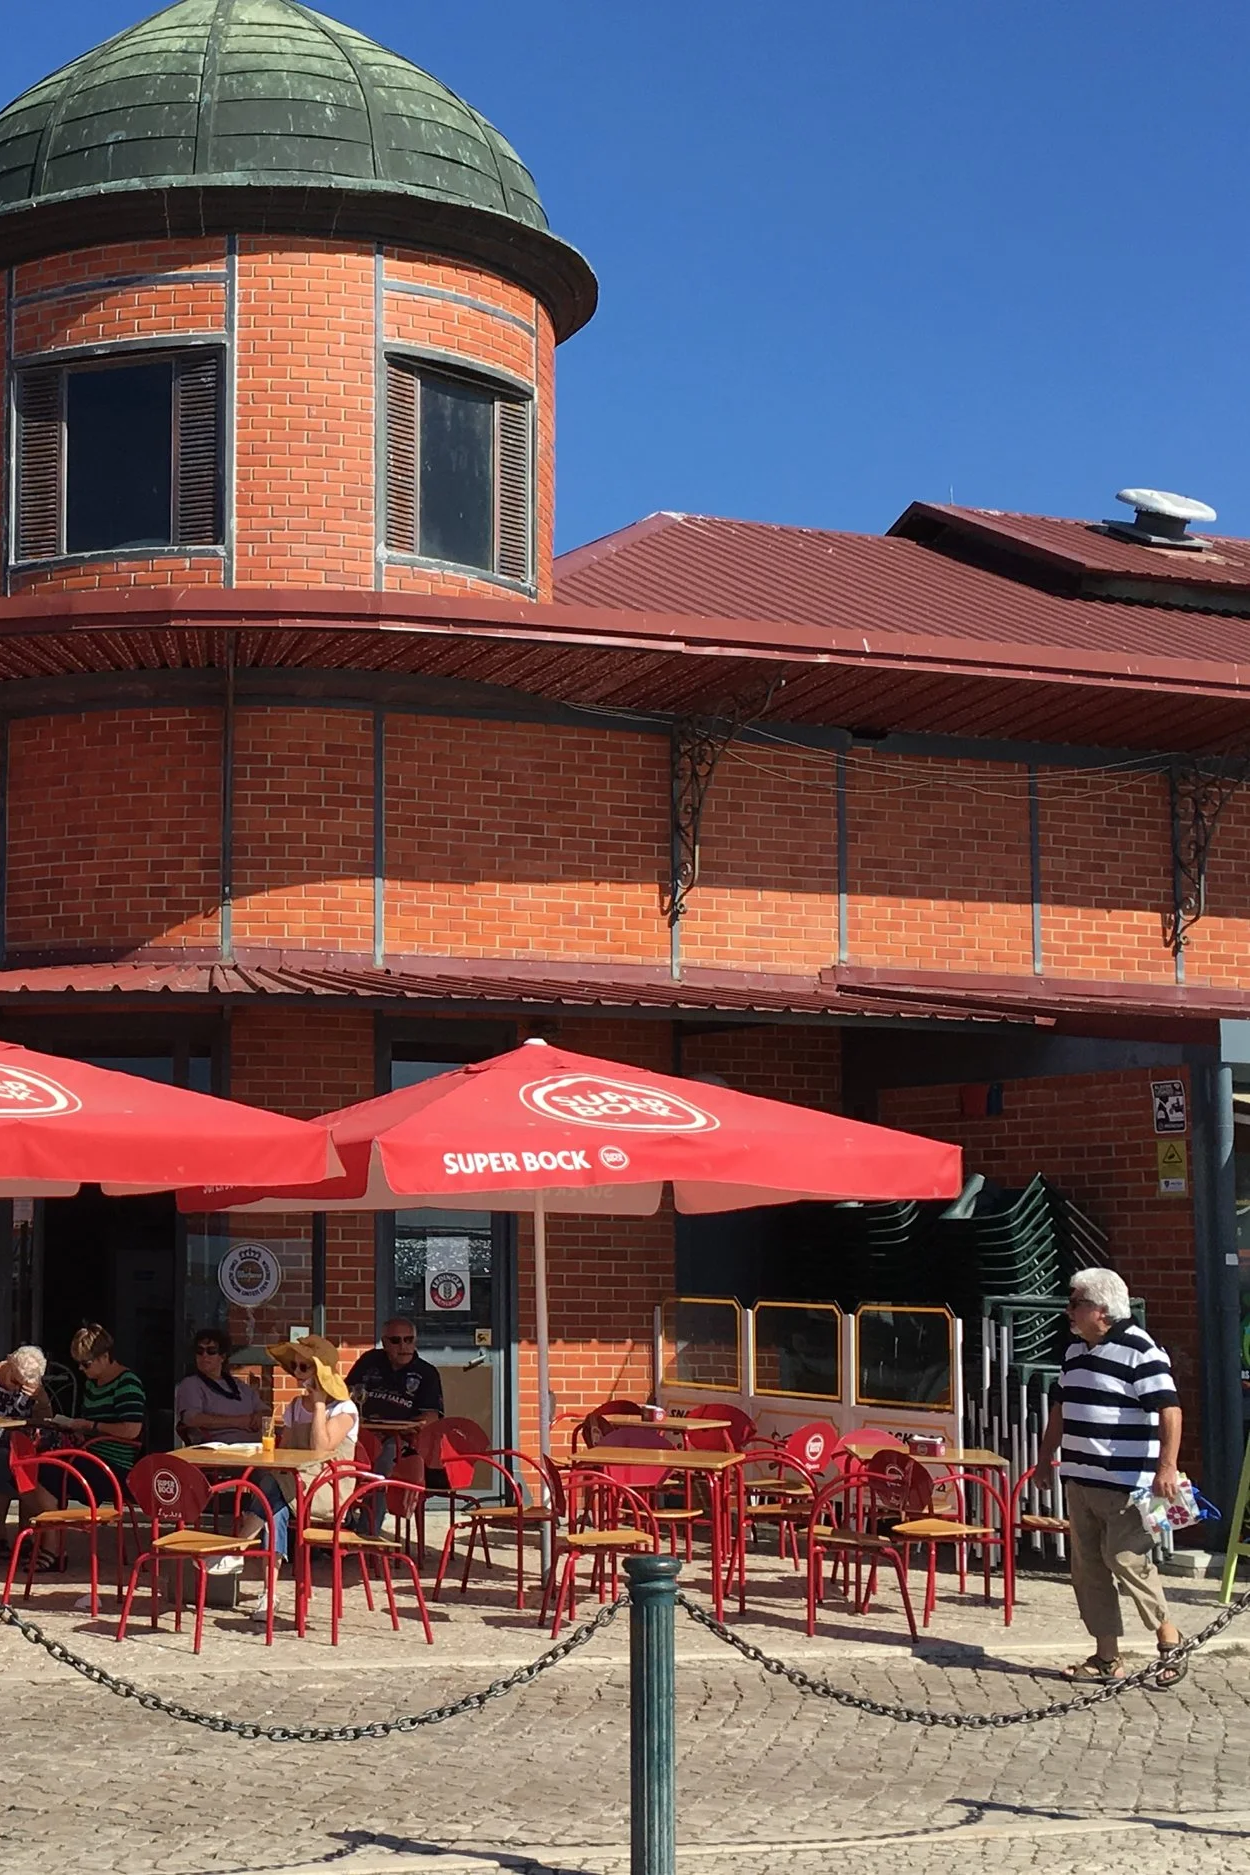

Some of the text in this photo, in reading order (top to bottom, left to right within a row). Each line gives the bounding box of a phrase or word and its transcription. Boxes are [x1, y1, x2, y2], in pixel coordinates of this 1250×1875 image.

[551, 1091, 672, 1110] SUPER
[570, 1103, 685, 1118] BOCK
[443, 1150, 591, 1175] SUPER BOCK
